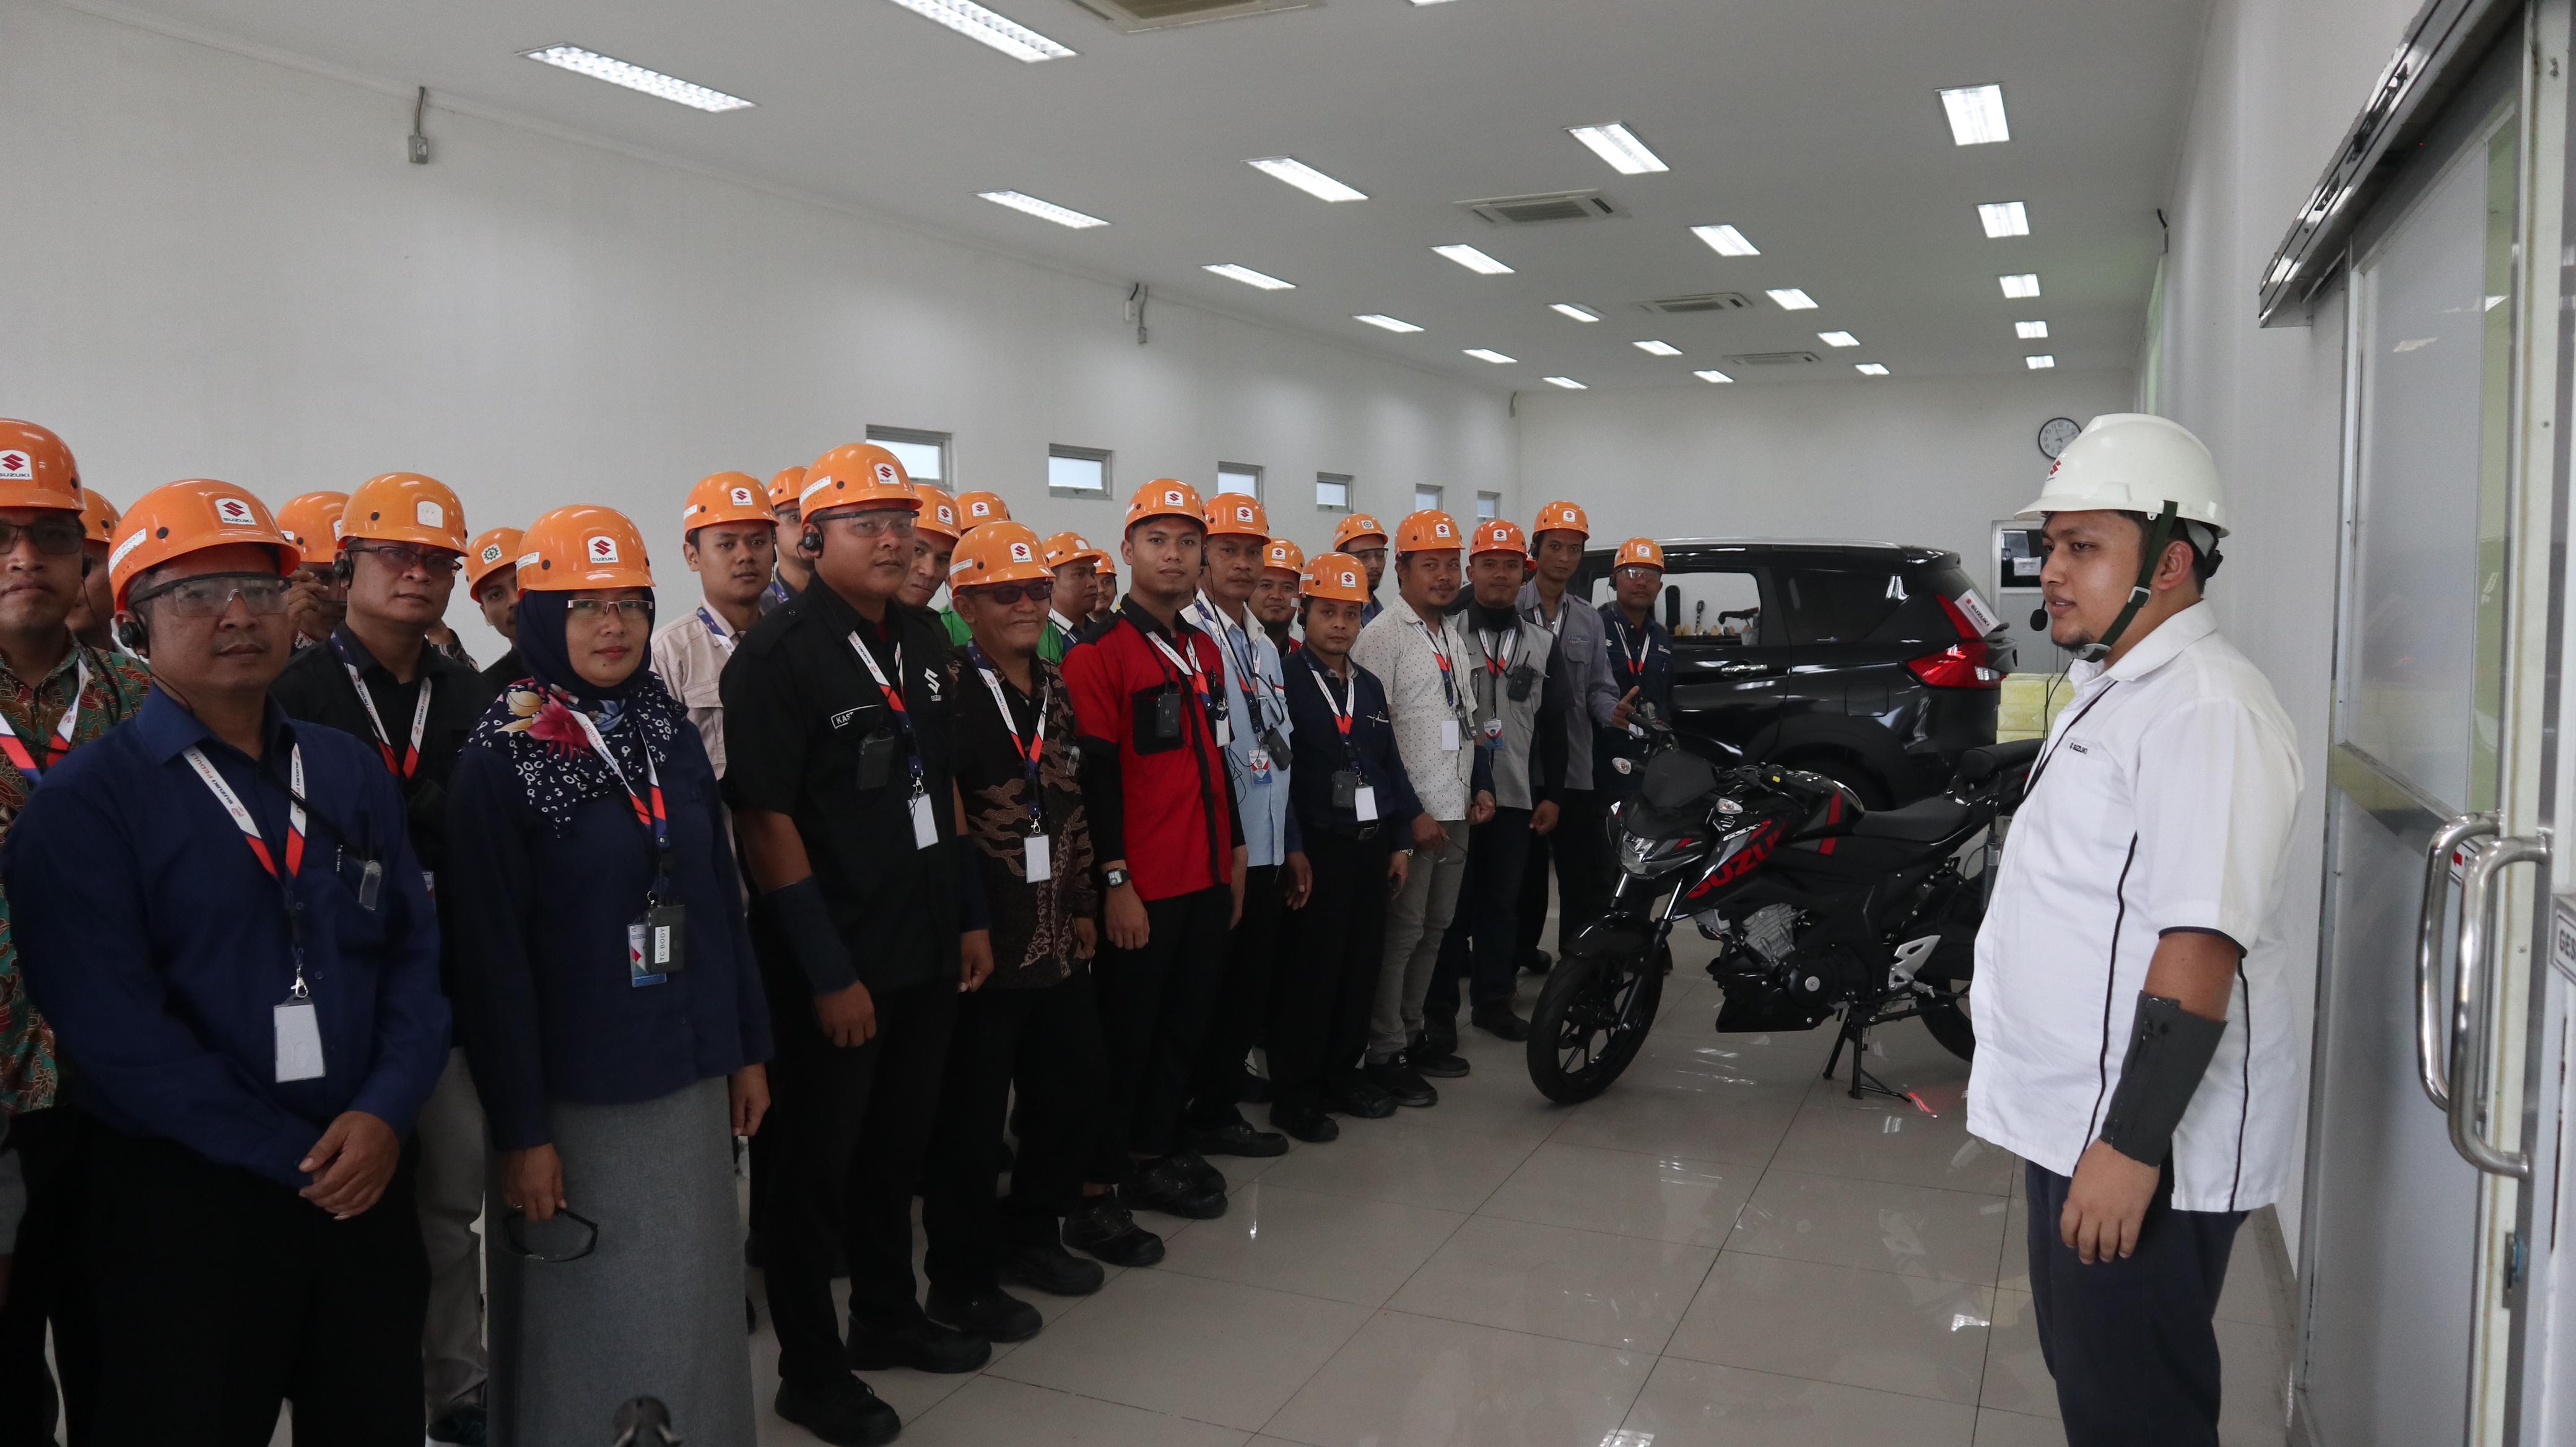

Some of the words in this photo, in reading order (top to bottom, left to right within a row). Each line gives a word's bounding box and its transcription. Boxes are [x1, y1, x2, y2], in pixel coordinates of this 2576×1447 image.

[1970, 604, 1990, 627] SUZUKI
[357, 684, 369, 706] SUZUKI
[584, 723, 601, 746] PEDULI
[2072, 744, 2089, 755] SUZUKI
[191, 753, 214, 779] PEDULI
[212, 779, 233, 805] SUZUKI
[659, 951, 665, 961] TC
